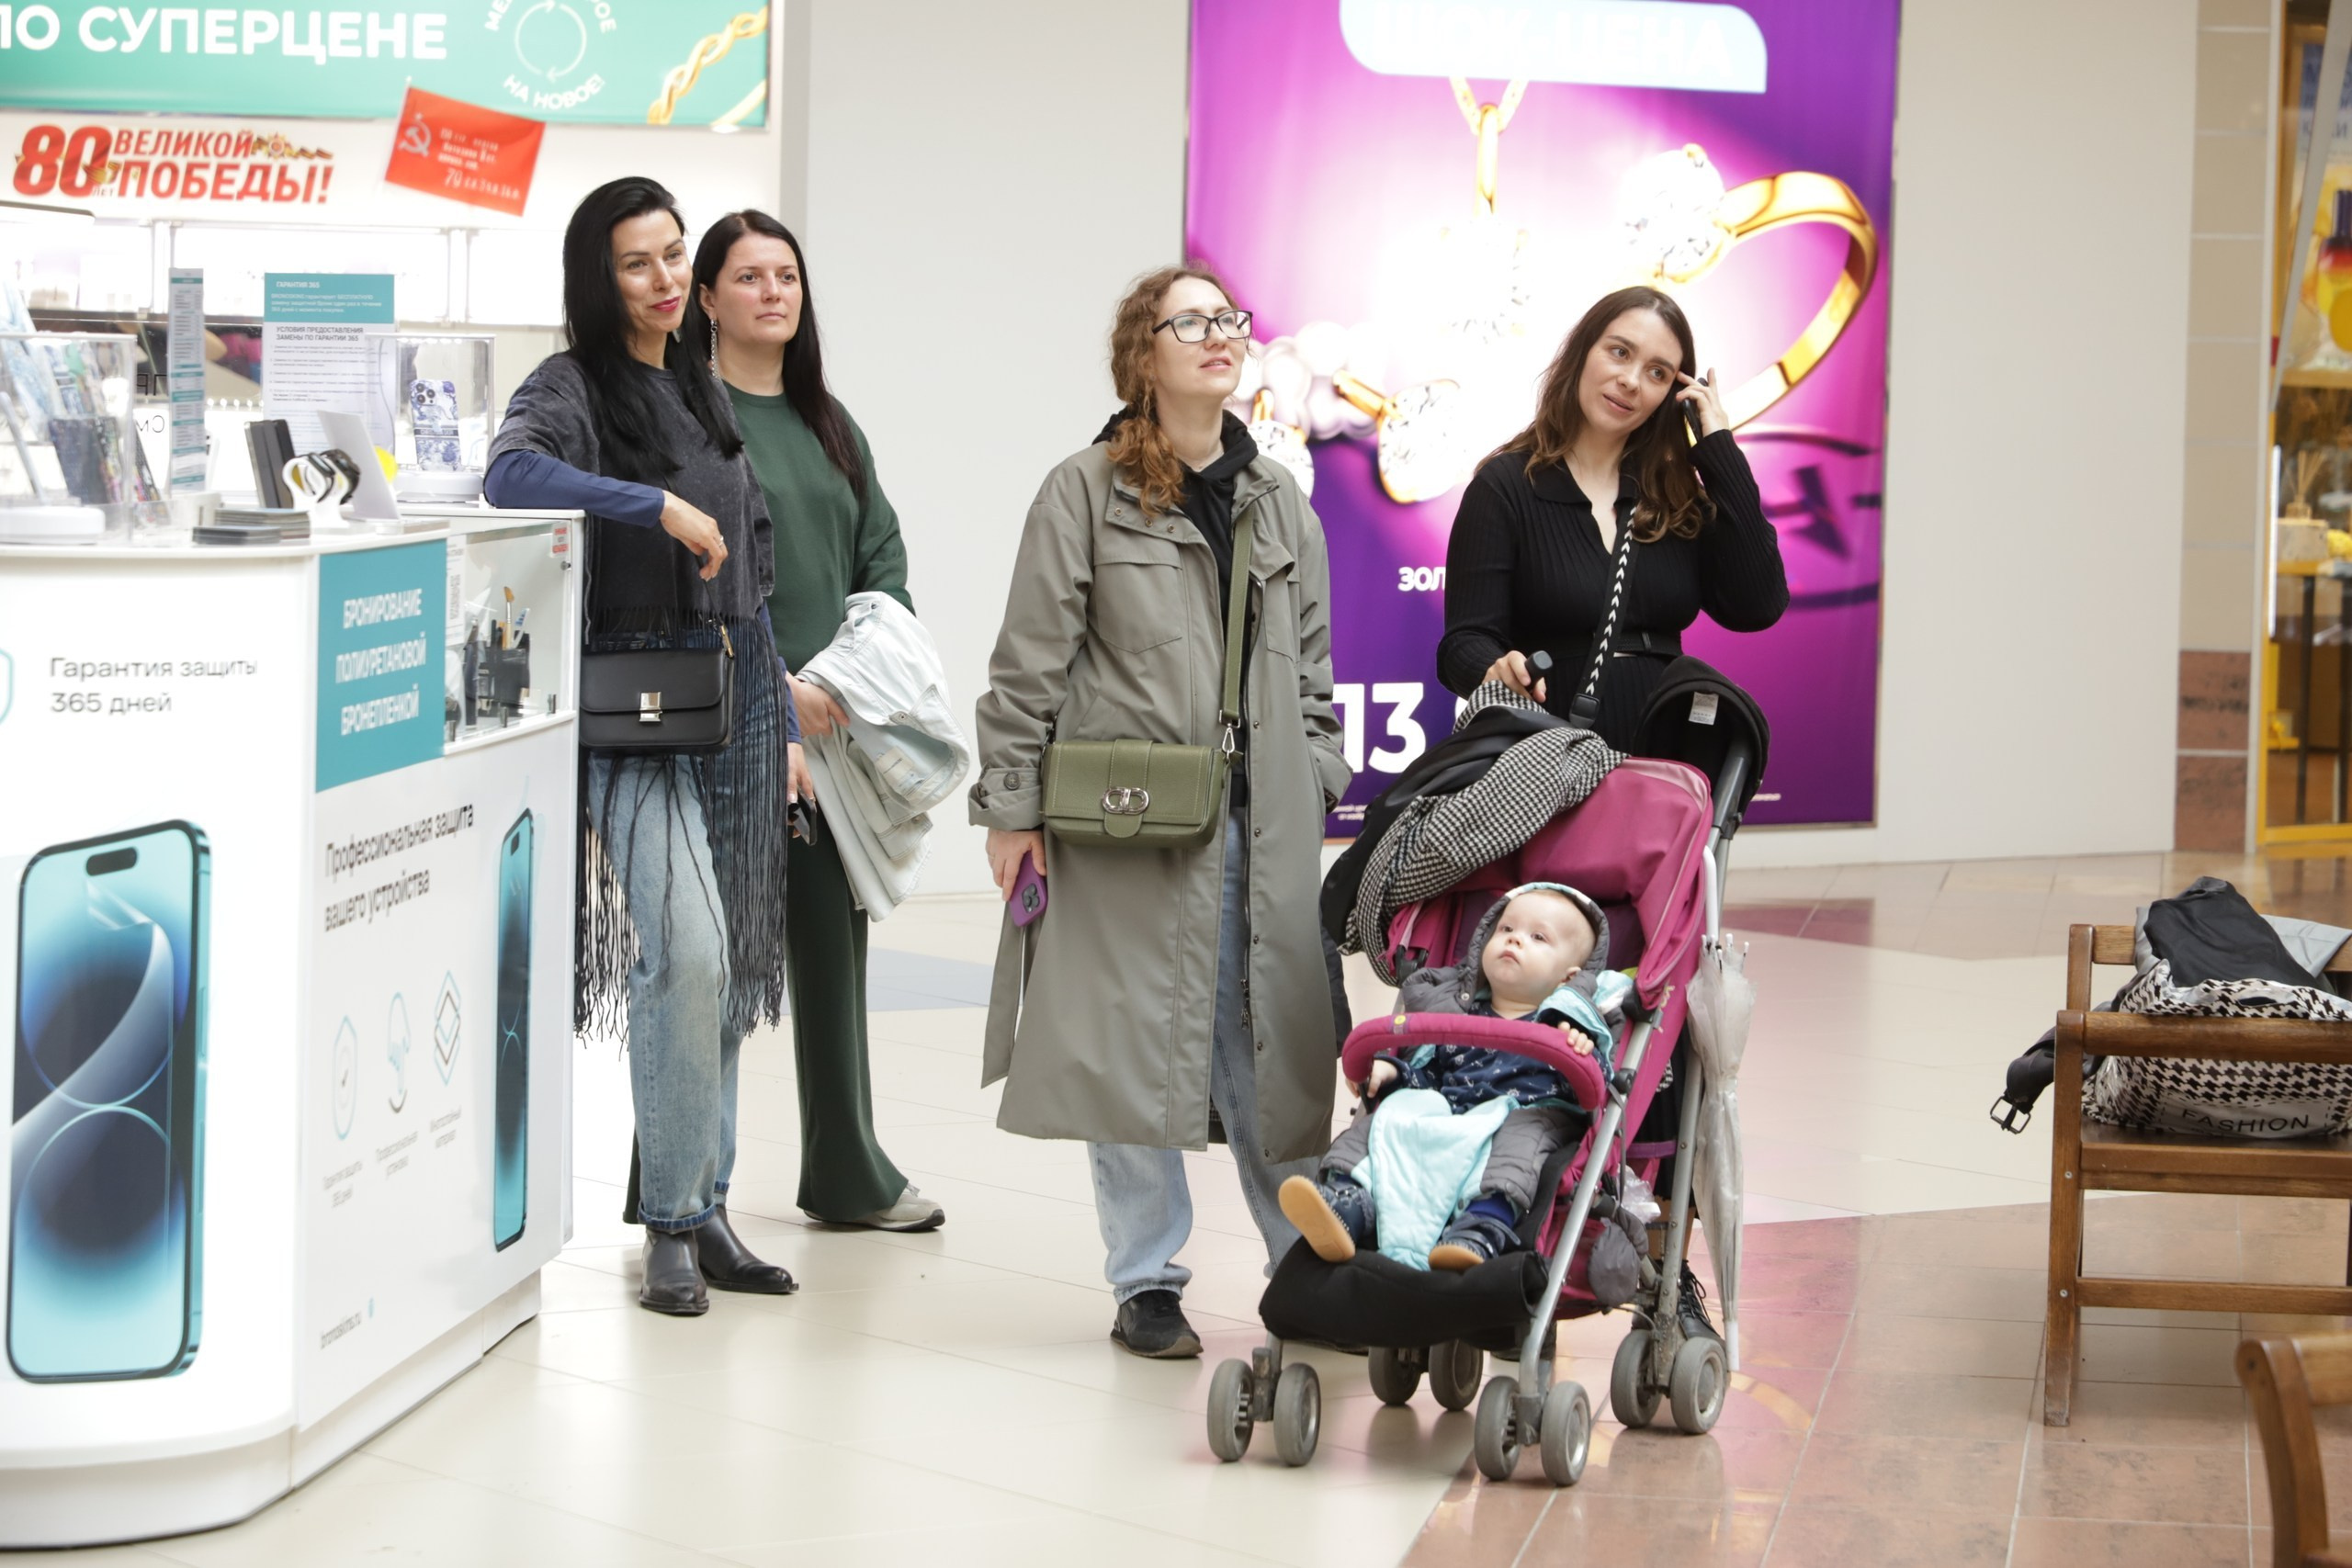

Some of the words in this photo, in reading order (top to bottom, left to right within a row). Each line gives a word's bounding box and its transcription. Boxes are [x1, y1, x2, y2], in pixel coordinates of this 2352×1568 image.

[78, 6, 447, 65] СУПЕРЦЕНЕ
[503, 73, 529, 103] НА
[13, 124, 112, 197] 80
[113, 129, 253, 158] ВЕЛИКОЙ
[118, 161, 334, 204] ПОБЕДЫ!
[343, 588, 422, 628] БРОНИРОВАНИЕ
[50, 658, 173, 682] Гарантия
[180, 660, 258, 679] защиты
[335, 631, 426, 683] ПОЛИУРЕТАНОВОЙ
[51, 693, 102, 713] 365
[109, 692, 172, 716] дней
[341, 683, 419, 736] БРОНЕПЛЕНКОЙ
[1332, 682, 1426, 773] 13
[325, 816, 433, 884] Профессиональная
[435, 804, 473, 838] защита
[325, 893, 366, 931] вашего
[368, 869, 430, 924] устройства
[2182, 1109, 2309, 1133] FASHION
